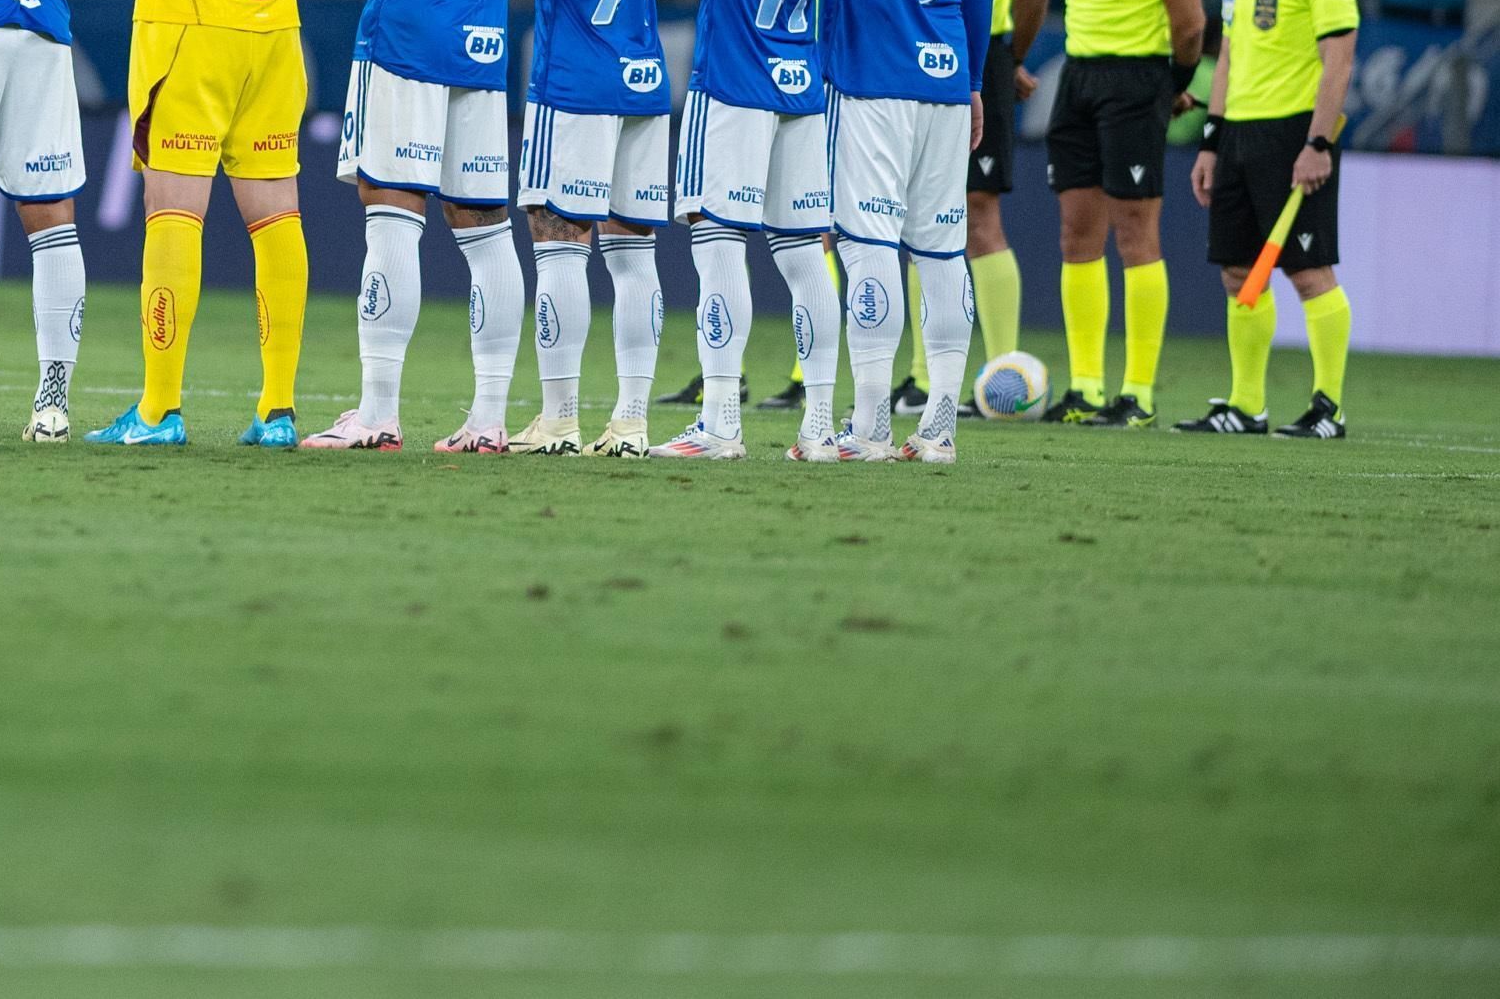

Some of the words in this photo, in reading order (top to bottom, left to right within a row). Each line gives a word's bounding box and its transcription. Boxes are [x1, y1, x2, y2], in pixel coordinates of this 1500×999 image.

[469, 37, 500, 56] BH
[924, 52, 954, 71] BH
[628, 67, 658, 84] BH
[778, 68, 806, 86] BH
[793, 198, 828, 210] MULT
[860, 282, 877, 324] Kodilar
[153, 292, 169, 344] Kodilar
[538, 301, 551, 342] Kodilar
[709, 299, 721, 343] Kodilar
